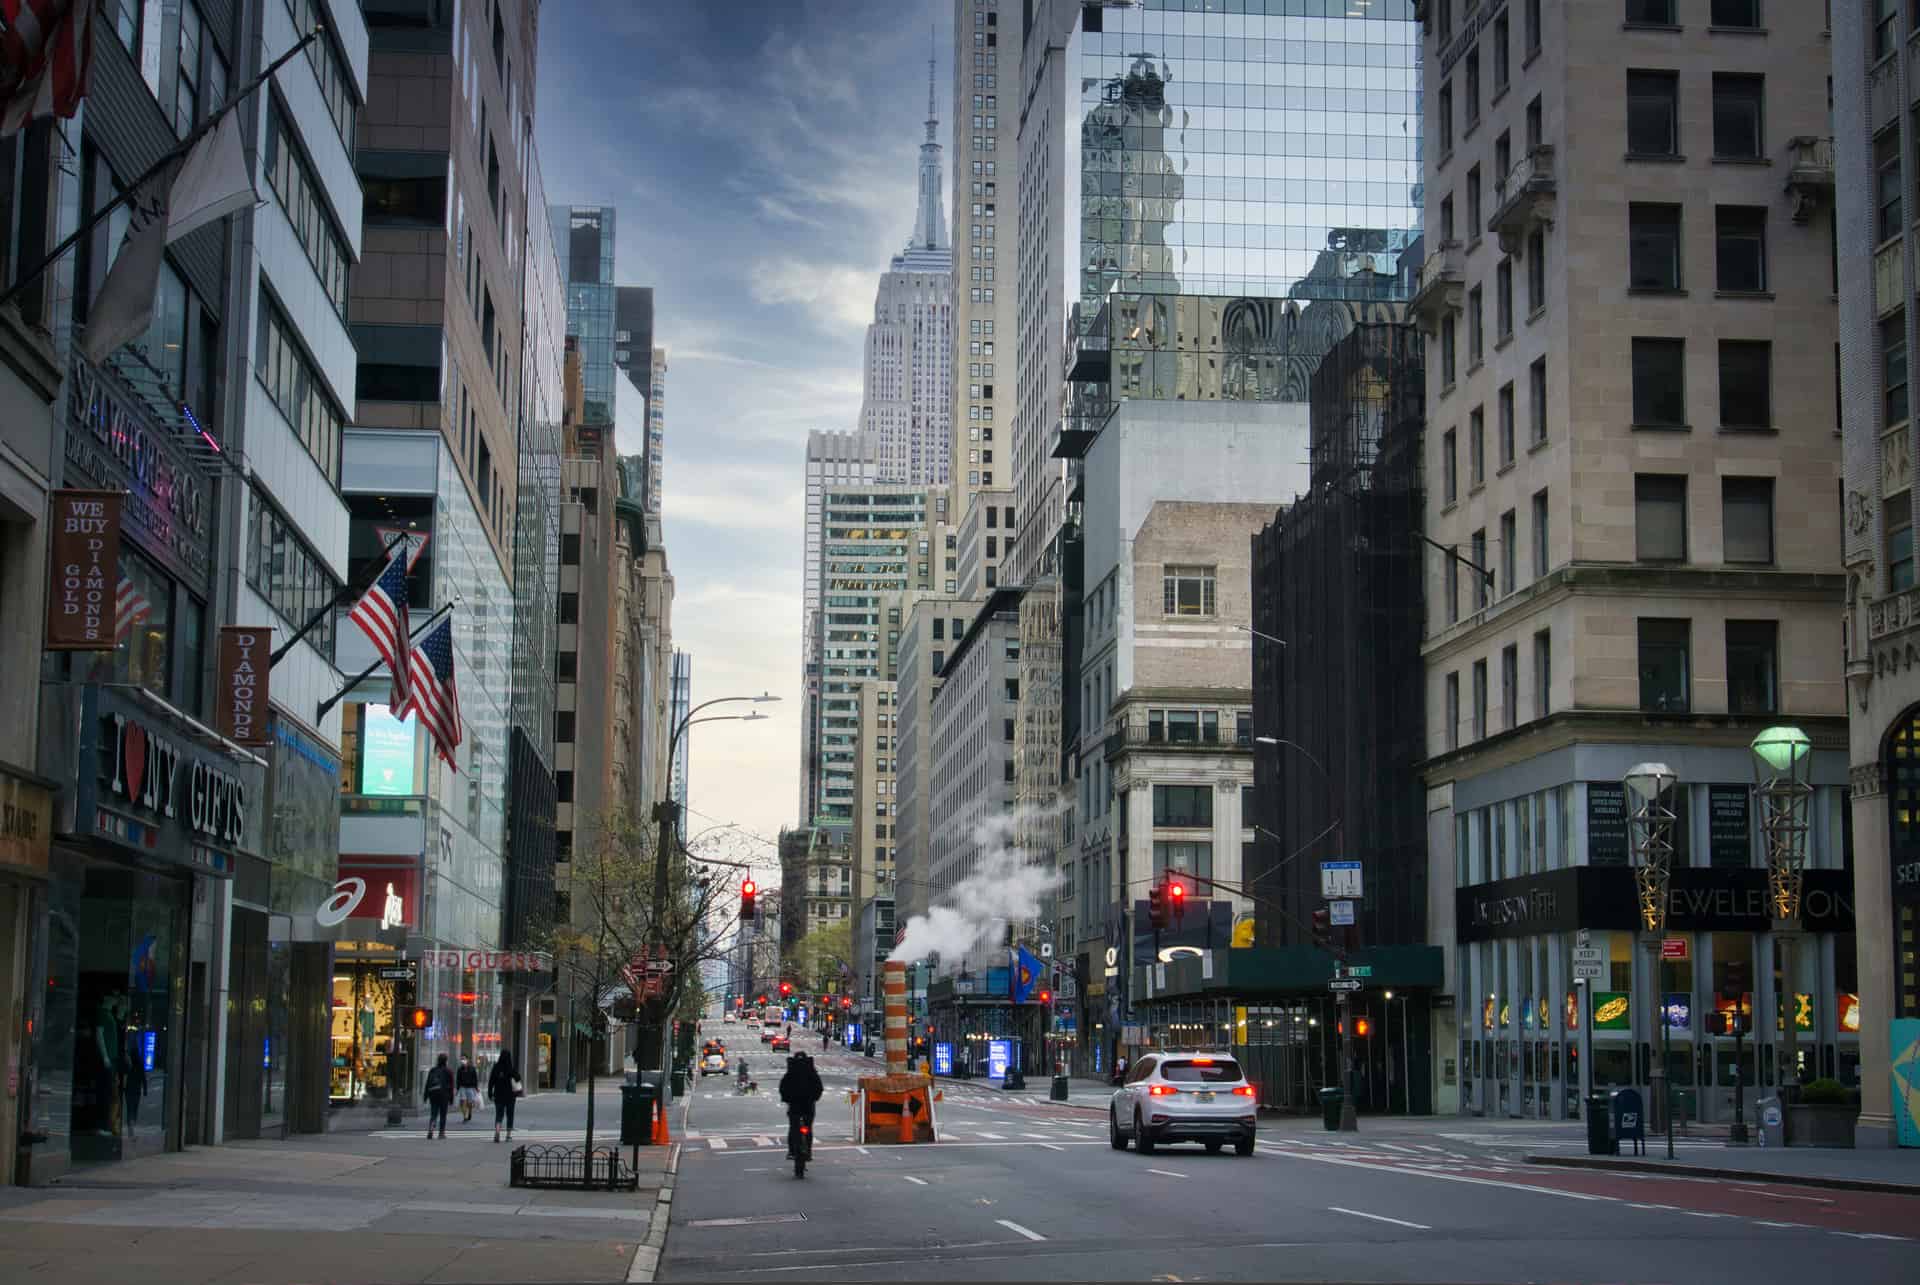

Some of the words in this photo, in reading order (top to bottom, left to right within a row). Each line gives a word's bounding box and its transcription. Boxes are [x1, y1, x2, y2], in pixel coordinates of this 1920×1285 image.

[64, 518, 109, 534] BUY
[71, 502, 104, 517] WE
[64, 564, 80, 615] GOLD
[85, 539, 104, 640] DIAMONDS
[232, 634, 256, 738] DIAMONDS
[112, 712, 125, 793] I
[143, 729, 181, 818] NY
[191, 756, 244, 847] GIFTS
[1668, 888, 1774, 917] EWELER
